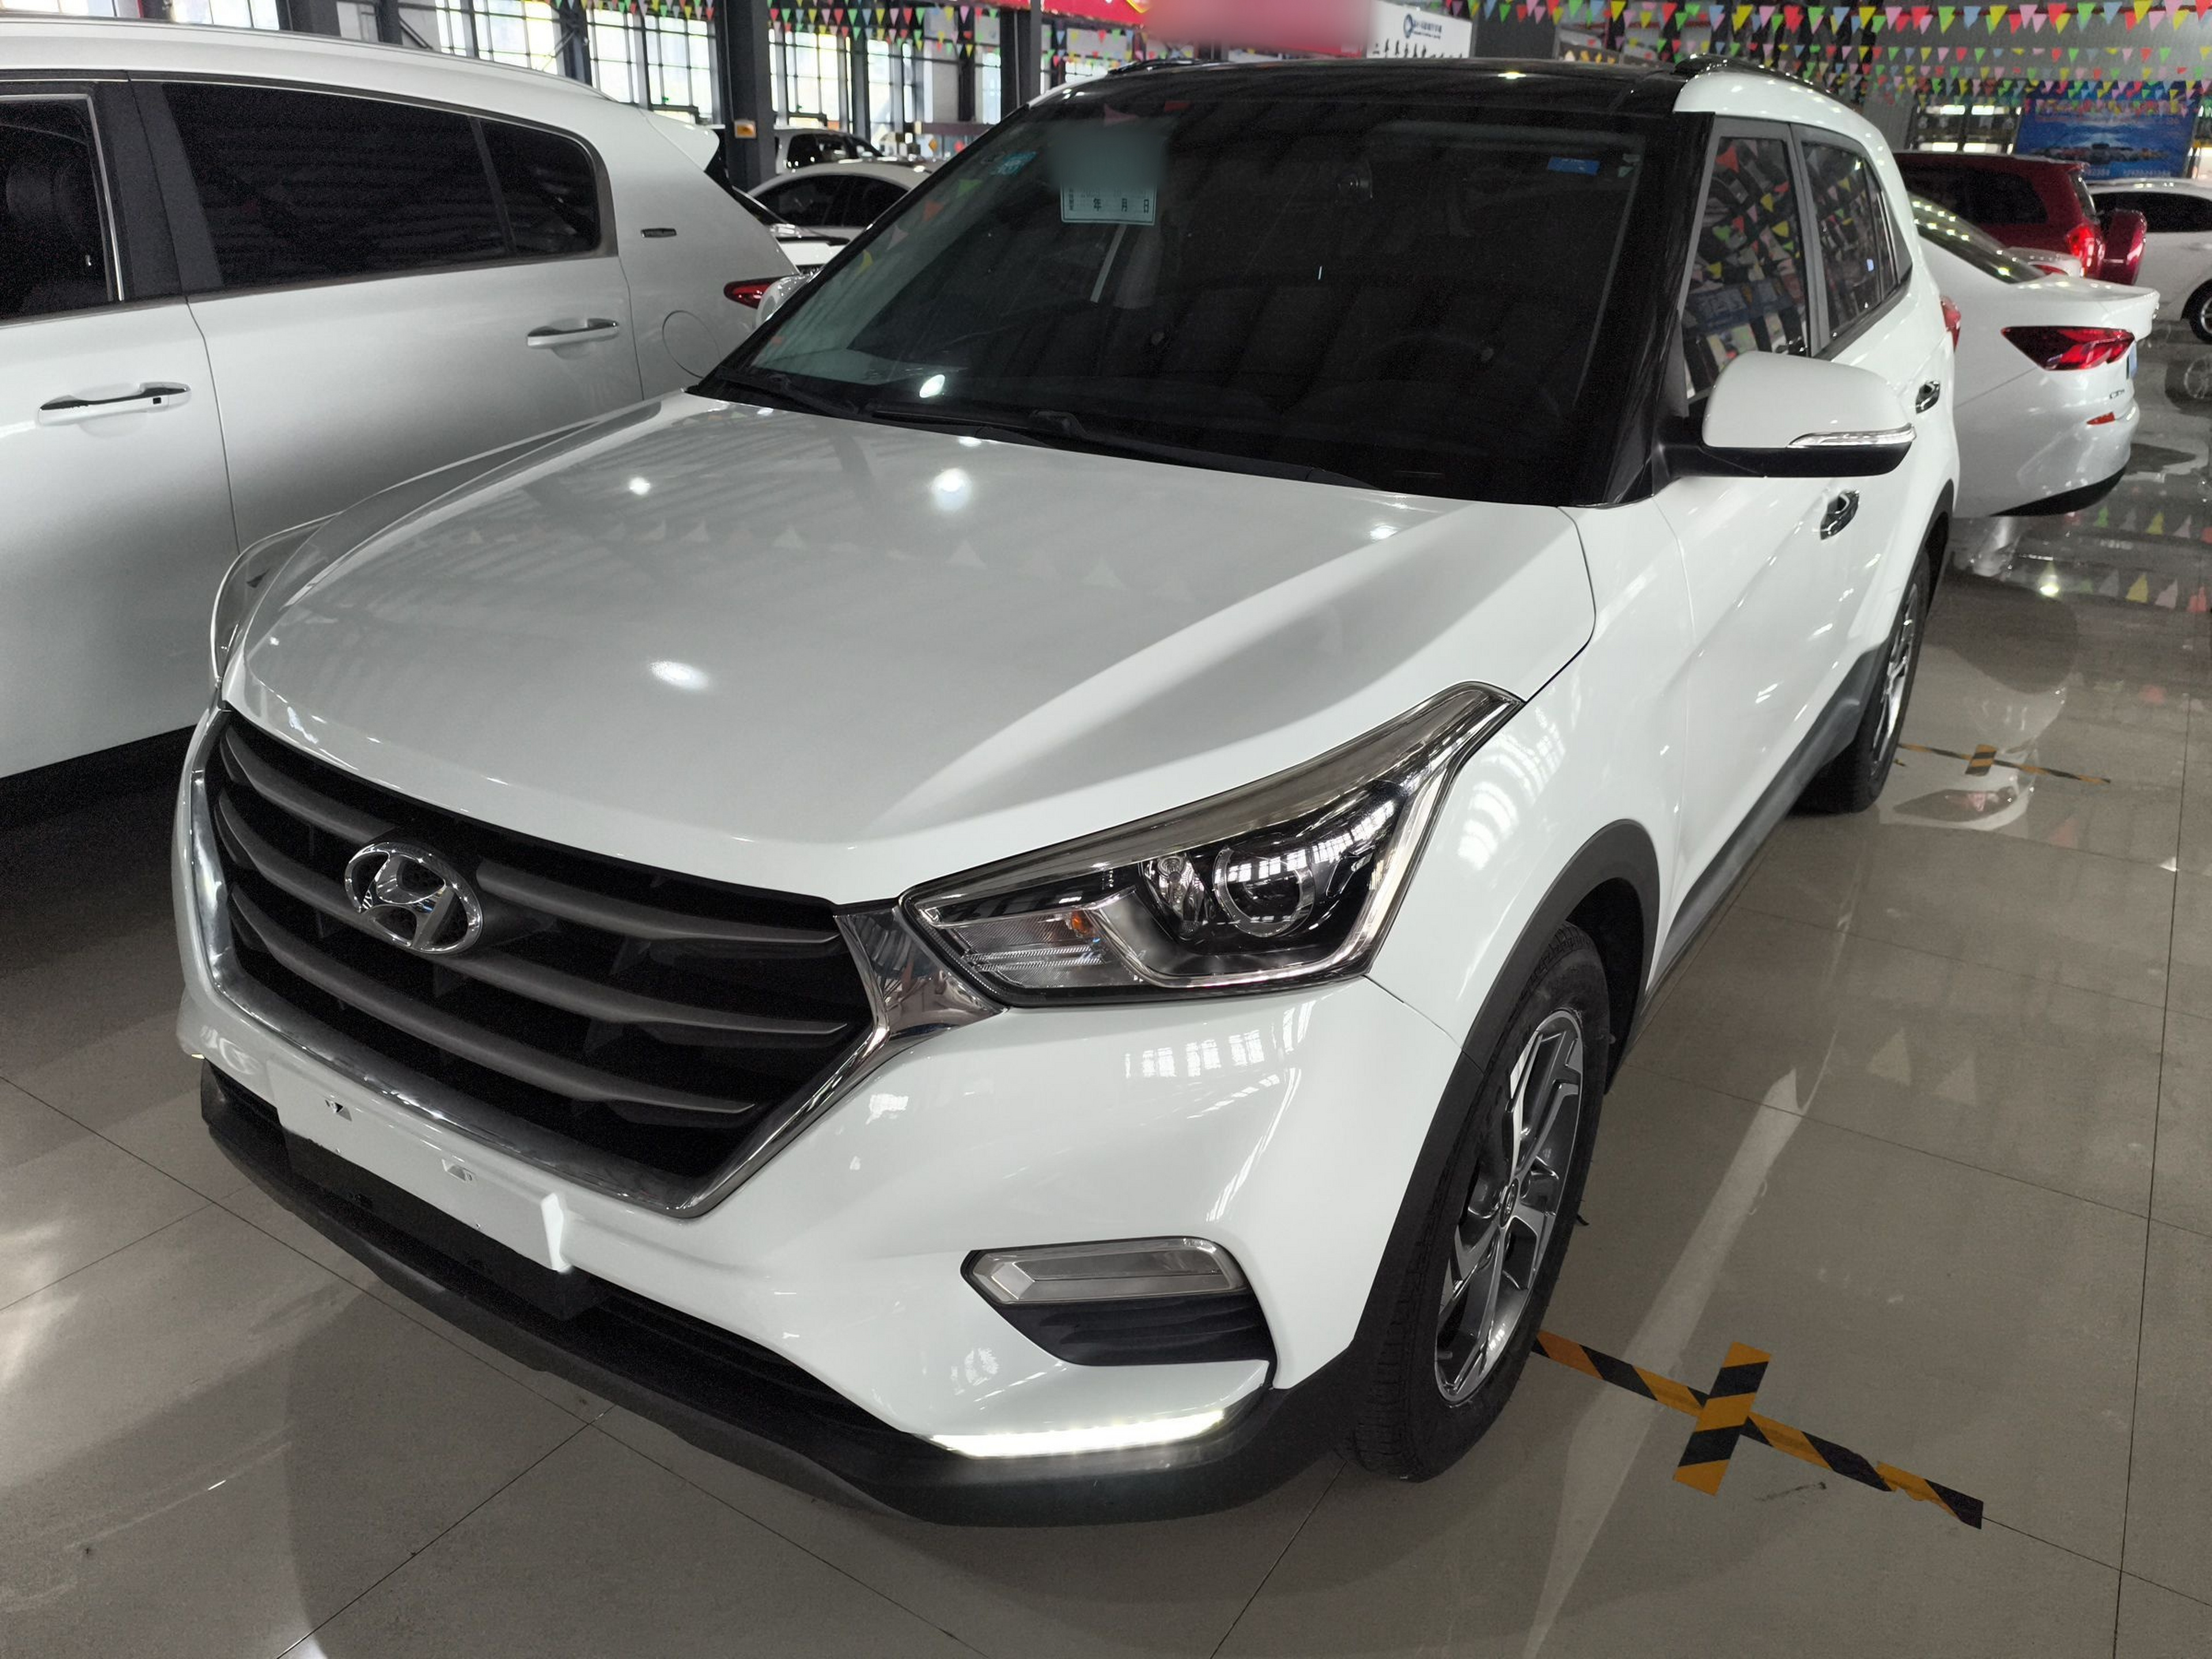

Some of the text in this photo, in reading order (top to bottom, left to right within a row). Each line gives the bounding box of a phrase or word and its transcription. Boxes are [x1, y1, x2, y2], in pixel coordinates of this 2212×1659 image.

[1093, 198, 1149, 214] 年 月 日
